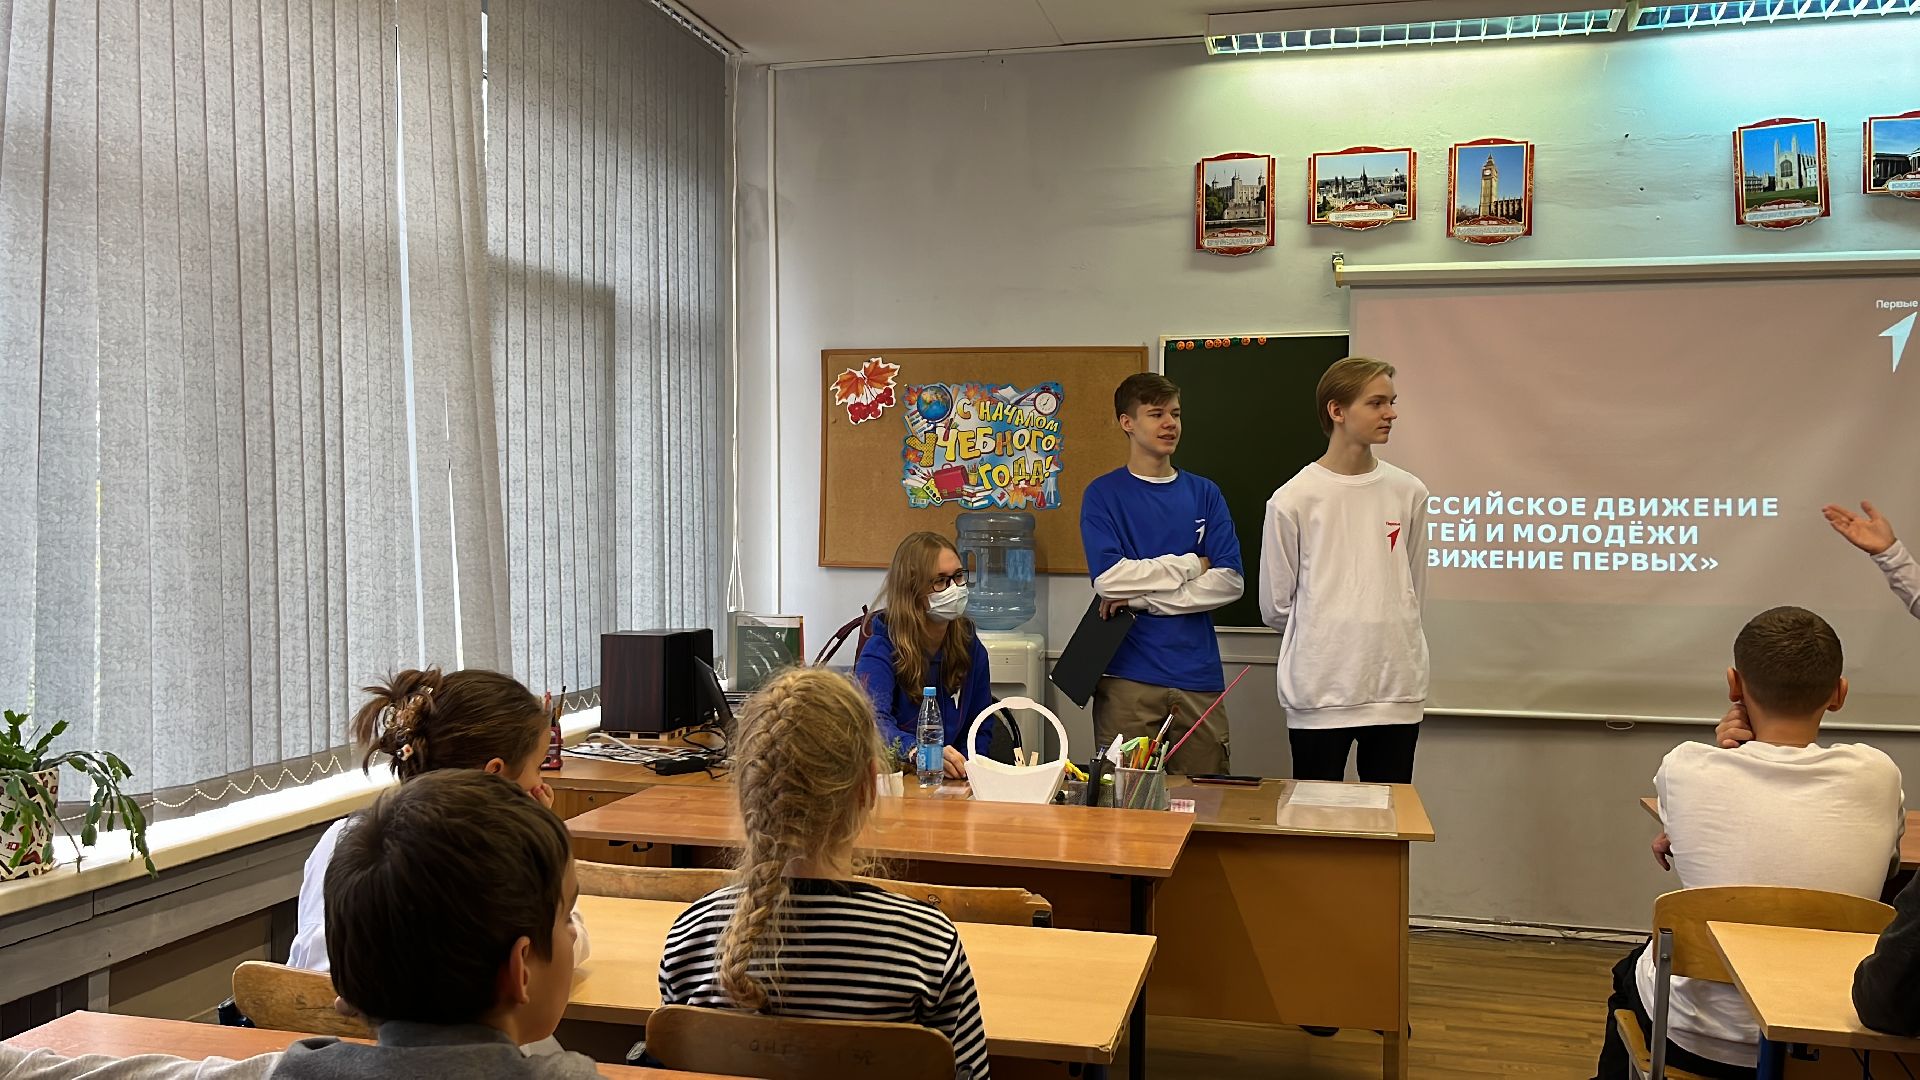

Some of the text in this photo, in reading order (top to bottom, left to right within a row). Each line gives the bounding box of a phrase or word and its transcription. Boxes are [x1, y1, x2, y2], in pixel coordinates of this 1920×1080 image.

[1876, 299, 1919, 311] Первые
[956, 398, 1060, 433] С НАЧАЛОМ
[905, 426, 1057, 468] УЧЕБНОГО
[978, 455, 1054, 490] ГОДА!
[1426, 490, 1779, 521] ССИЙСКОЕ ДВИЖЕНИЕ
[1486, 523, 1504, 543] И
[1513, 520, 1699, 548] МОЛОДЁЖИ
[1573, 551, 1719, 572] ПЕРВЫХ»
